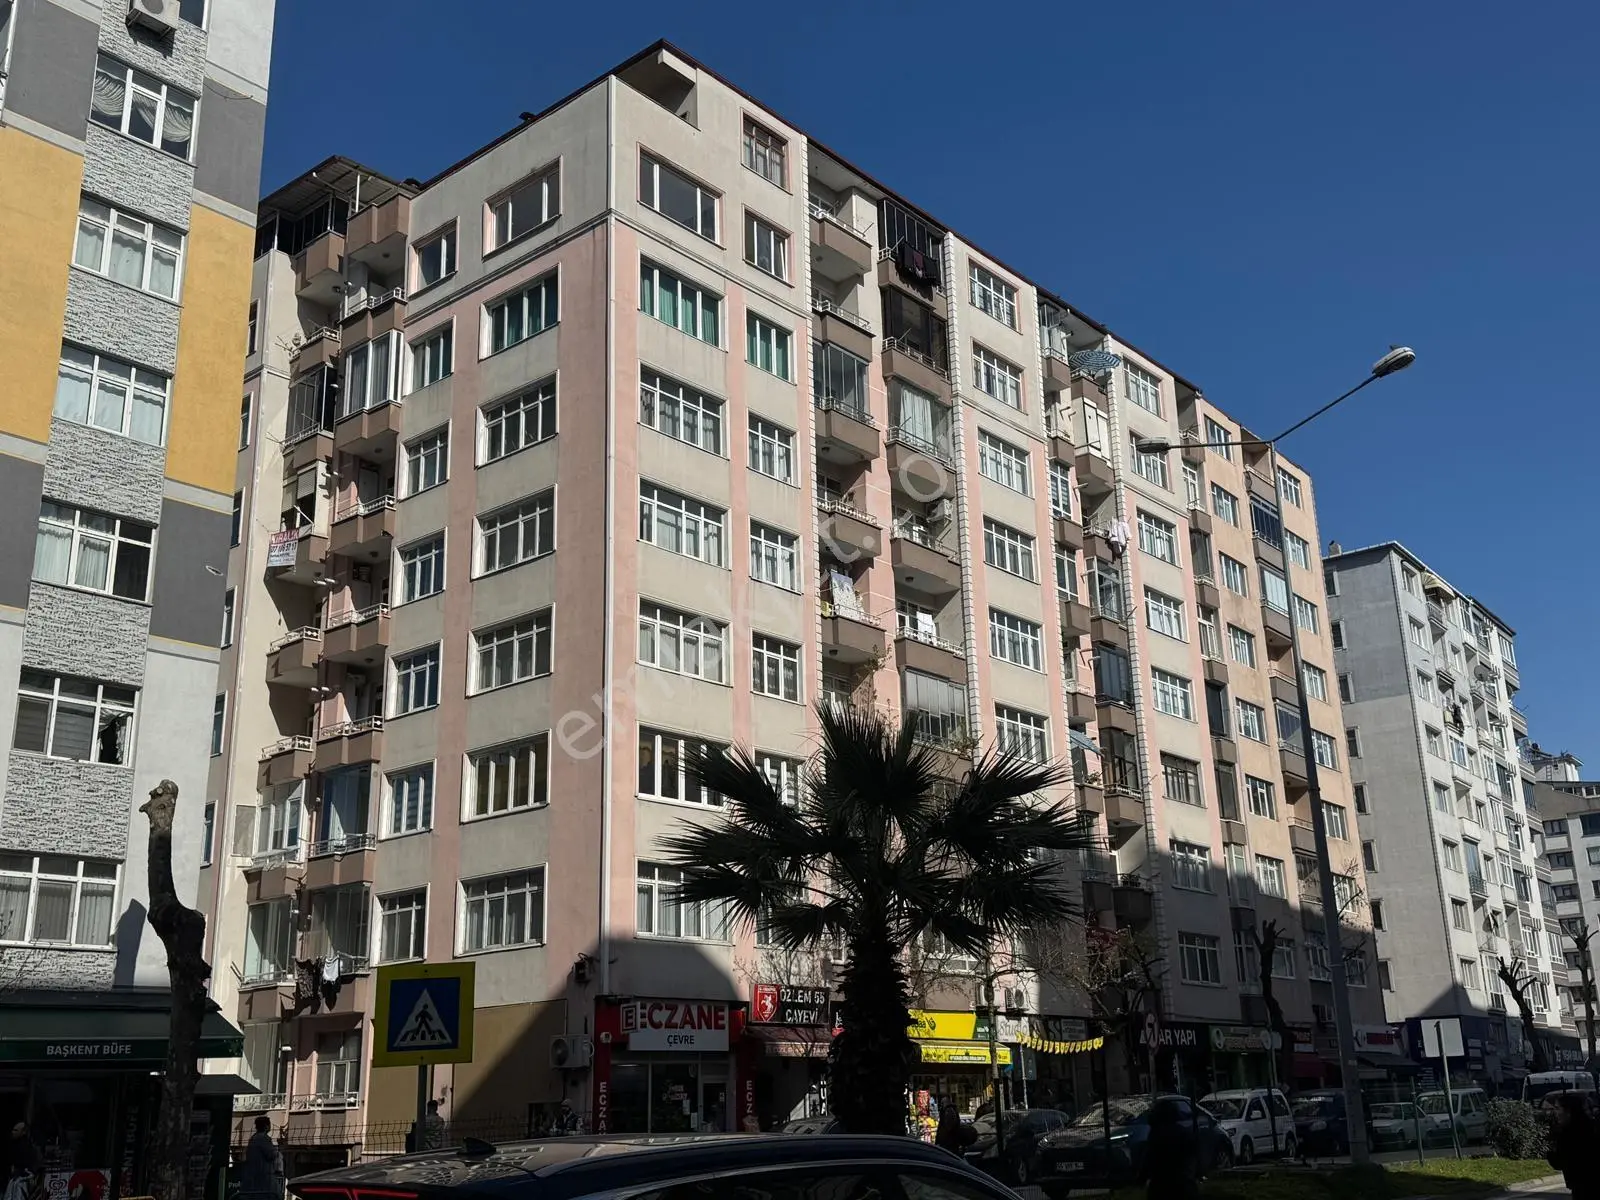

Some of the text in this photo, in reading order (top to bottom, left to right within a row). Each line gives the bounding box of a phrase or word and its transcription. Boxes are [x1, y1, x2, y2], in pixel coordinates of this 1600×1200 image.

[780, 985, 825, 1004] ÖZLEM 55
[667, 1034, 695, 1047] ÇEVRE
[1139, 1028, 1196, 1046] AAR YAPI
[46, 1042, 132, 1058] BAŞKENT BÜFE
[745, 1080, 754, 1114] ECZ
[598, 1081, 607, 1135] ECZA
